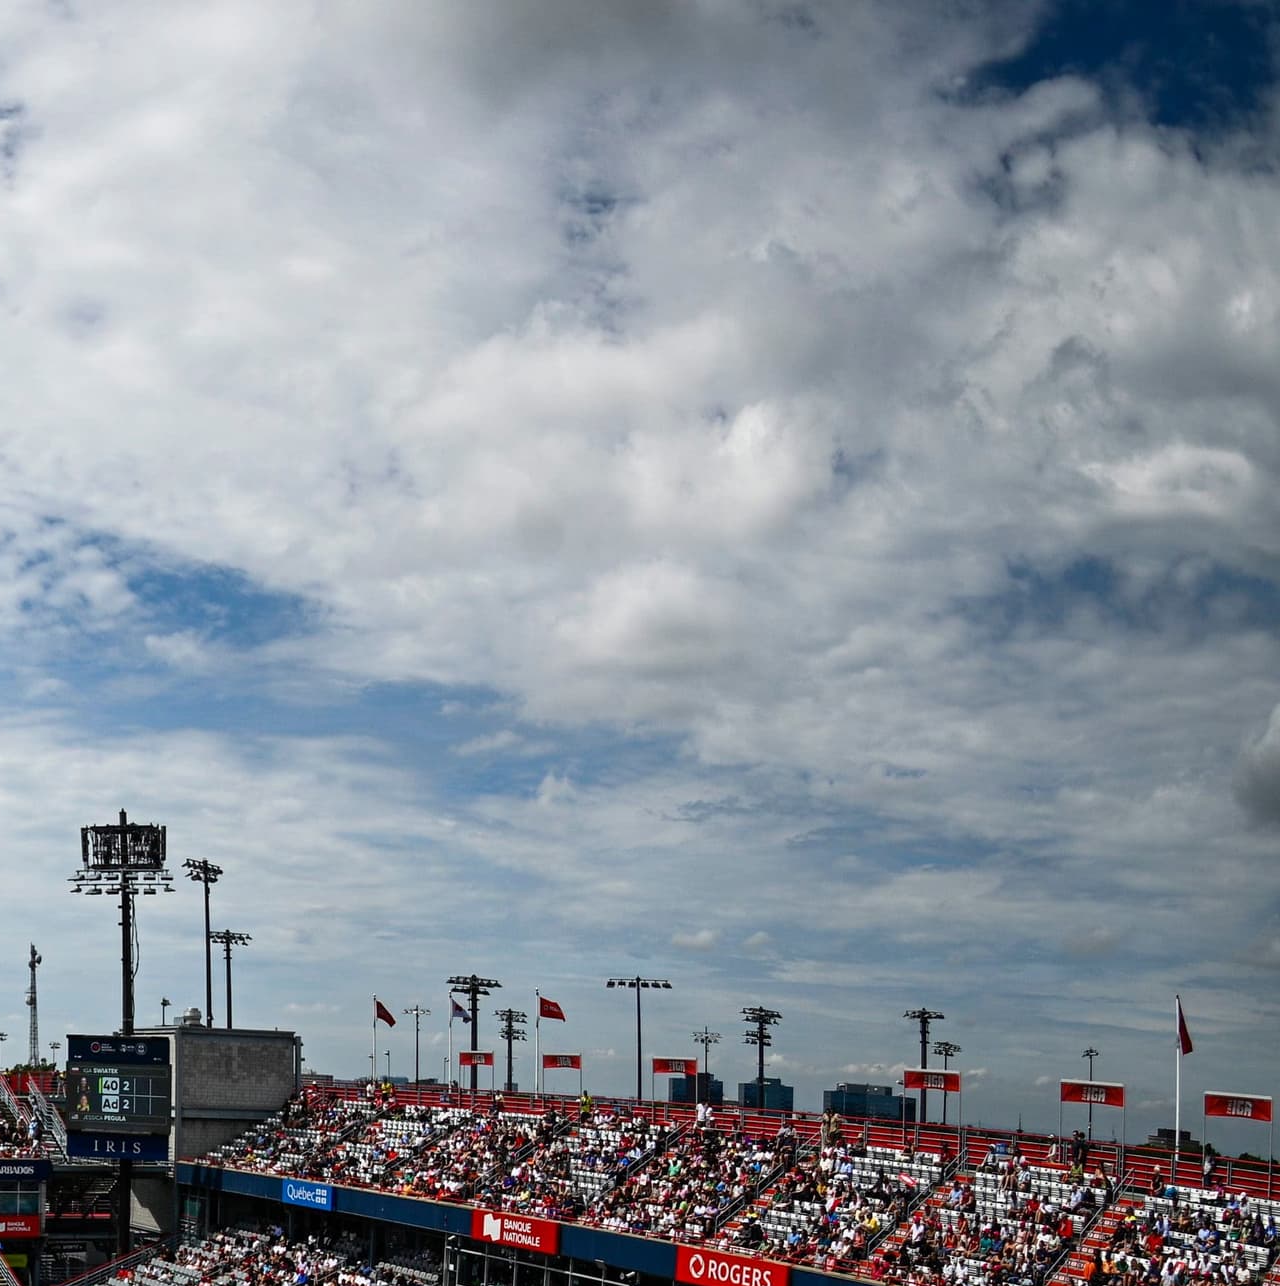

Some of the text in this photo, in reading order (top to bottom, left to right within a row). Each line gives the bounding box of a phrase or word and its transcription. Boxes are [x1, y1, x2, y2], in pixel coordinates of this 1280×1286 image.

[103, 1081, 130, 1091] 40 2
[1087, 1087, 1105, 1102] IGA
[103, 1100, 130, 1109] Ad 2
[1231, 1100, 1252, 1116] IGA
[94, 1140, 141, 1154] IRIS
[287, 1183, 315, 1202] Québec
[504, 1218, 532, 1233] BANQUE
[503, 1231, 540, 1247] NATIONALE
